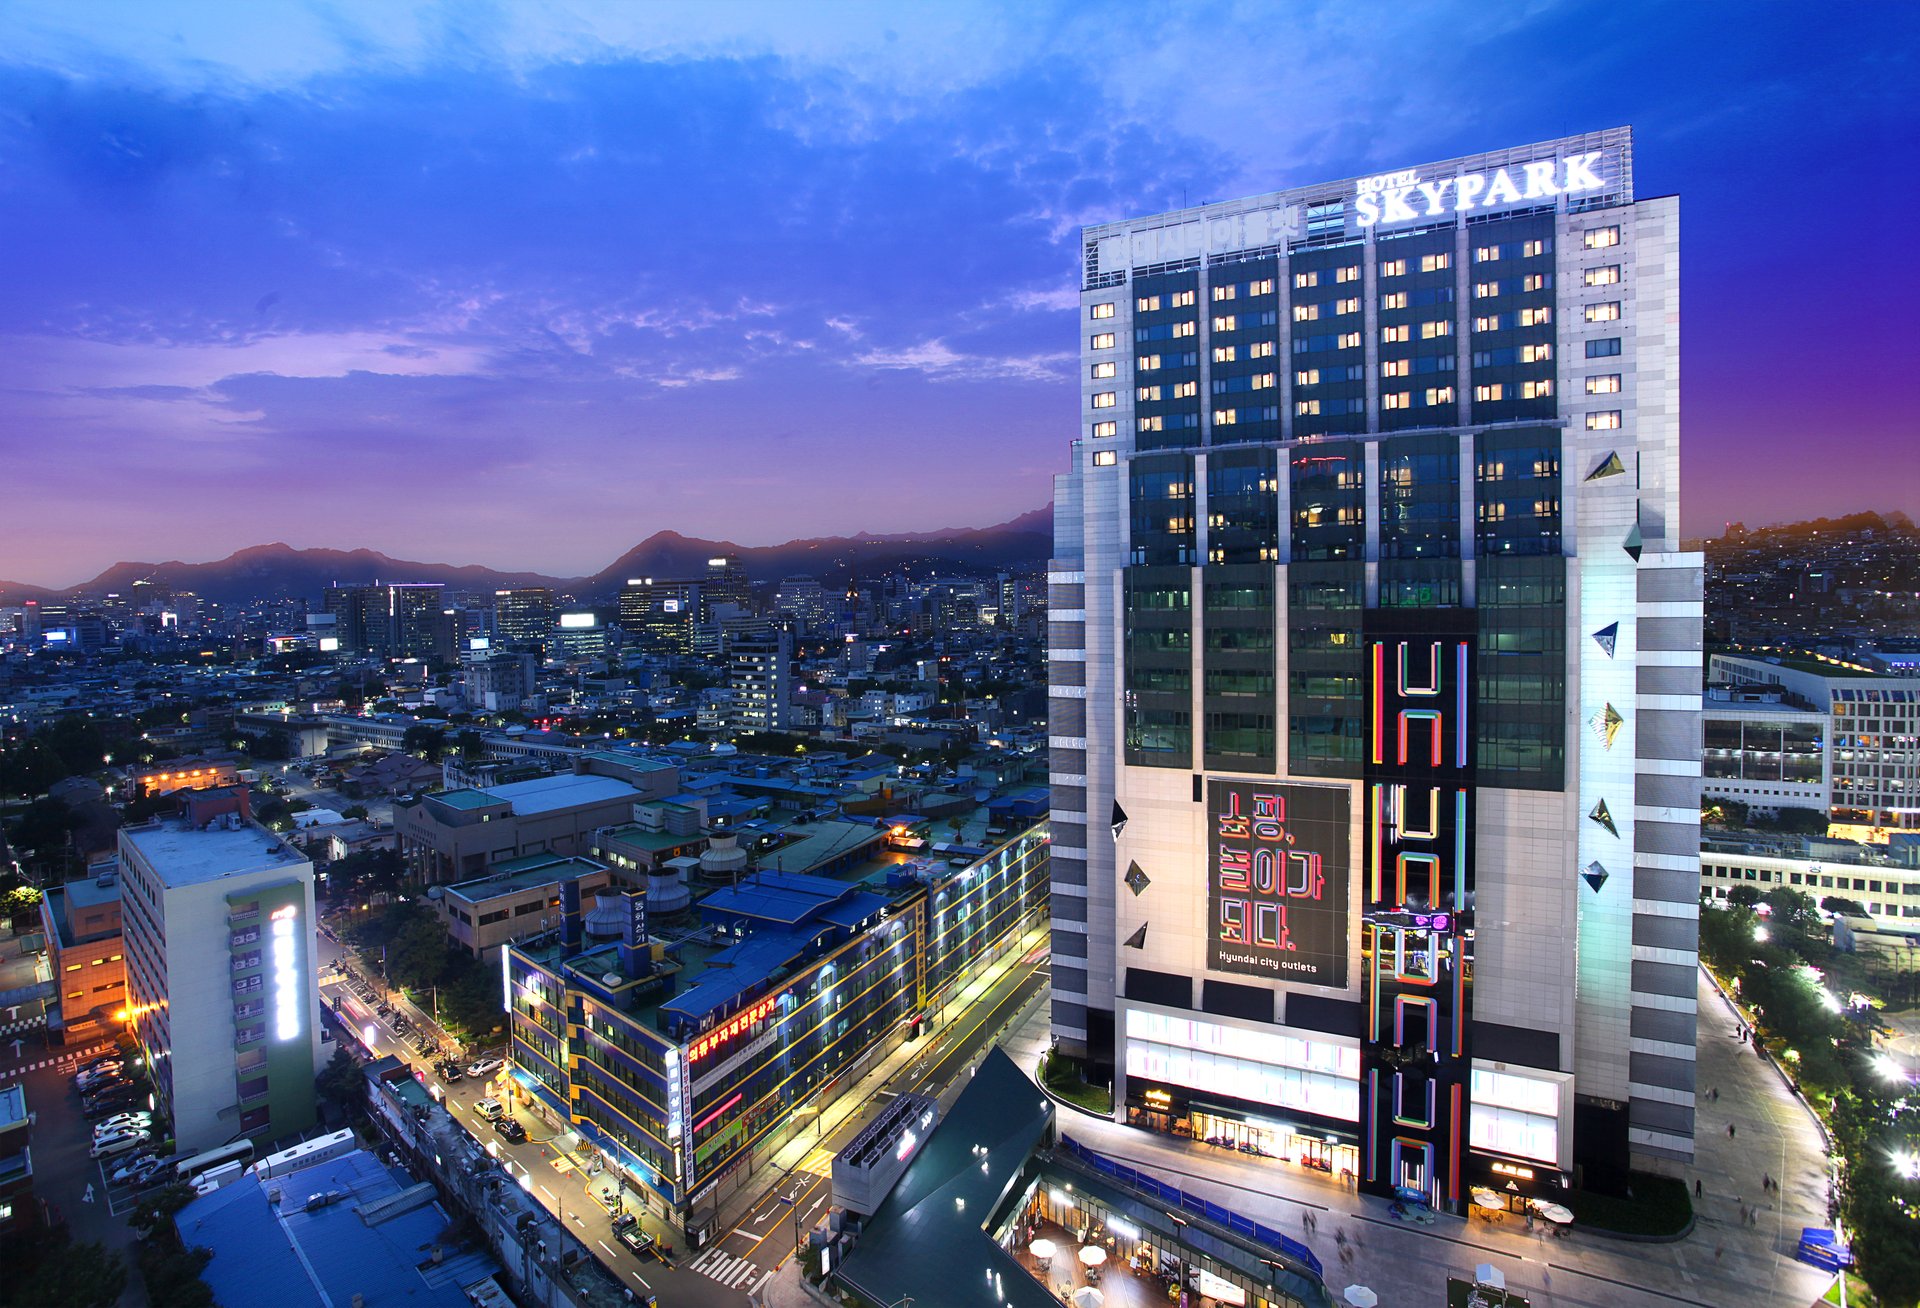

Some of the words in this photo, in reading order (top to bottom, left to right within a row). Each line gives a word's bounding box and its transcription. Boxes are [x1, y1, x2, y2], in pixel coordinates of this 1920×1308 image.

[1355, 151, 1606, 227] SKYPARK
[1357, 169, 1421, 195] HOTEL
[634, 901, 645, 942] 동화상가
[1219, 951, 1258, 964] Hyundai
[1260, 957, 1279, 969] city
[1281, 961, 1317, 974] outlets
